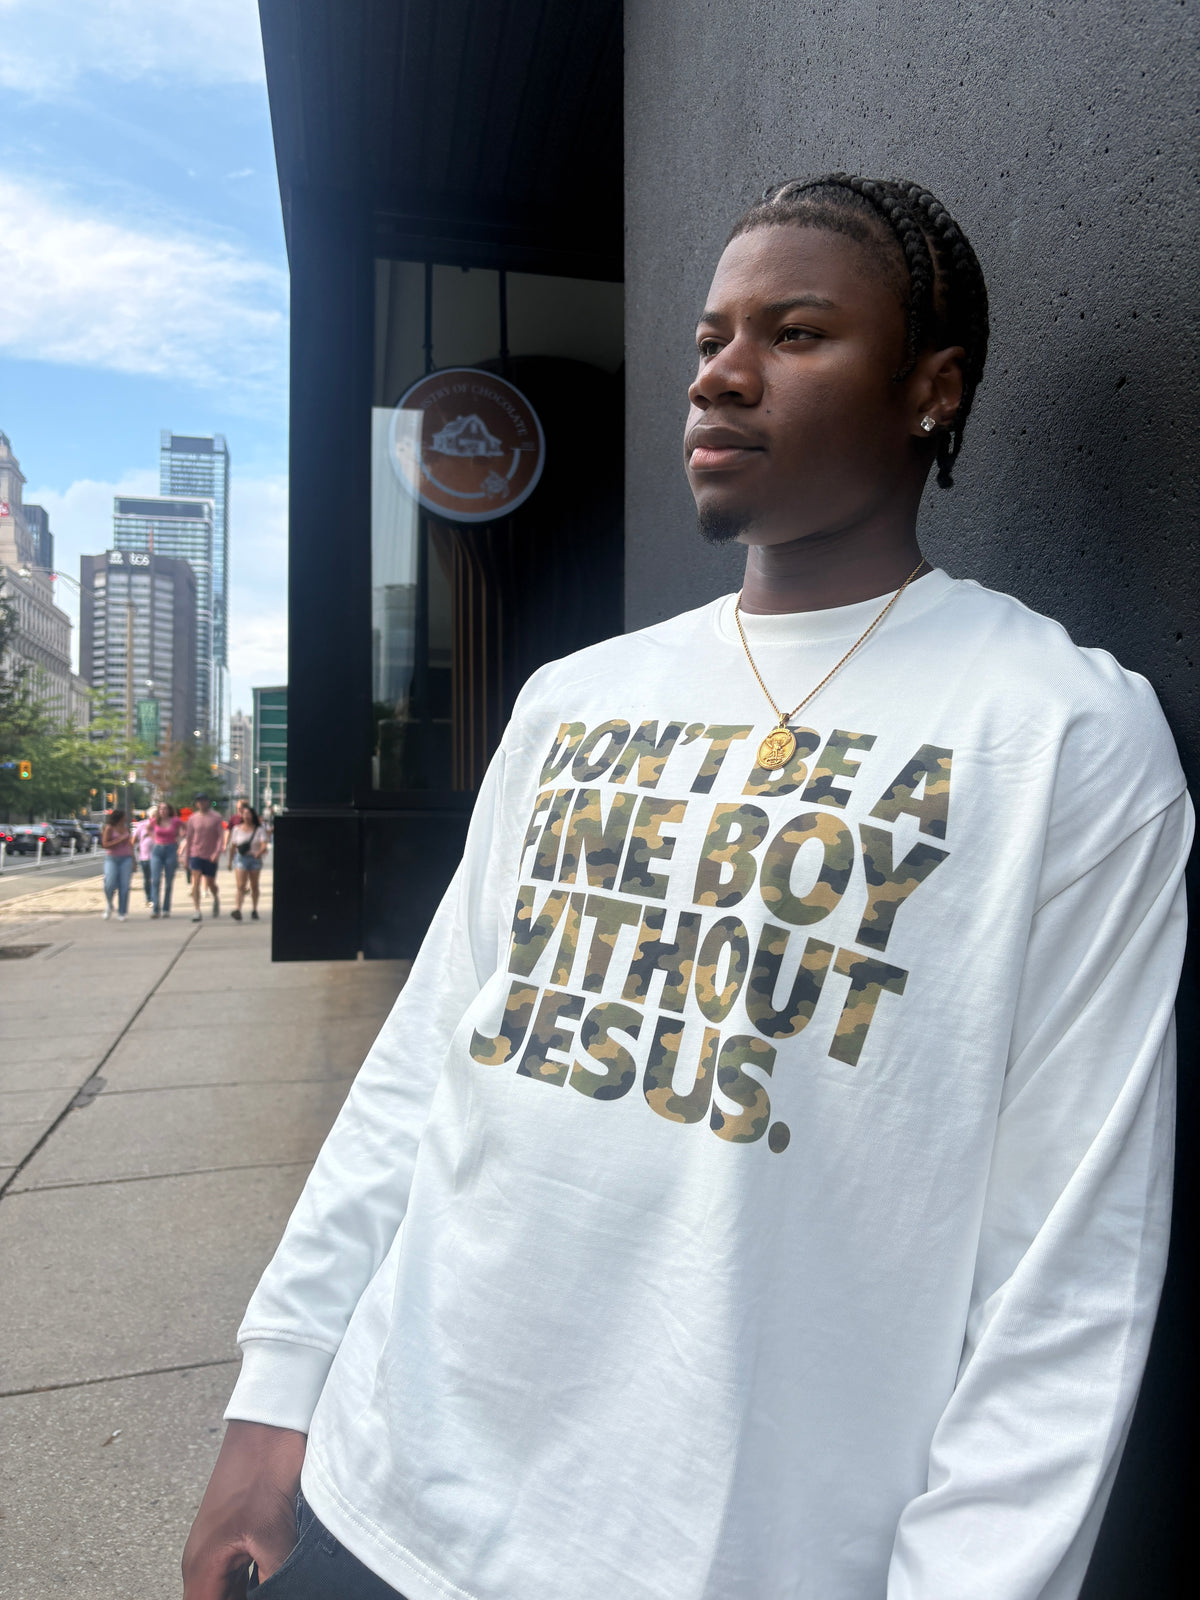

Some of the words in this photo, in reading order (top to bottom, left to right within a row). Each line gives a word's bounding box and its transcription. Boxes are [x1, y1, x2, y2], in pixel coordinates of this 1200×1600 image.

[539, 718, 754, 794] DON'T
[741, 725, 877, 809] BE
[868, 744, 953, 840] A
[518, 788, 689, 900] FINE
[692, 803, 950, 952] BOY
[469, 980, 791, 1153] JESUS.
